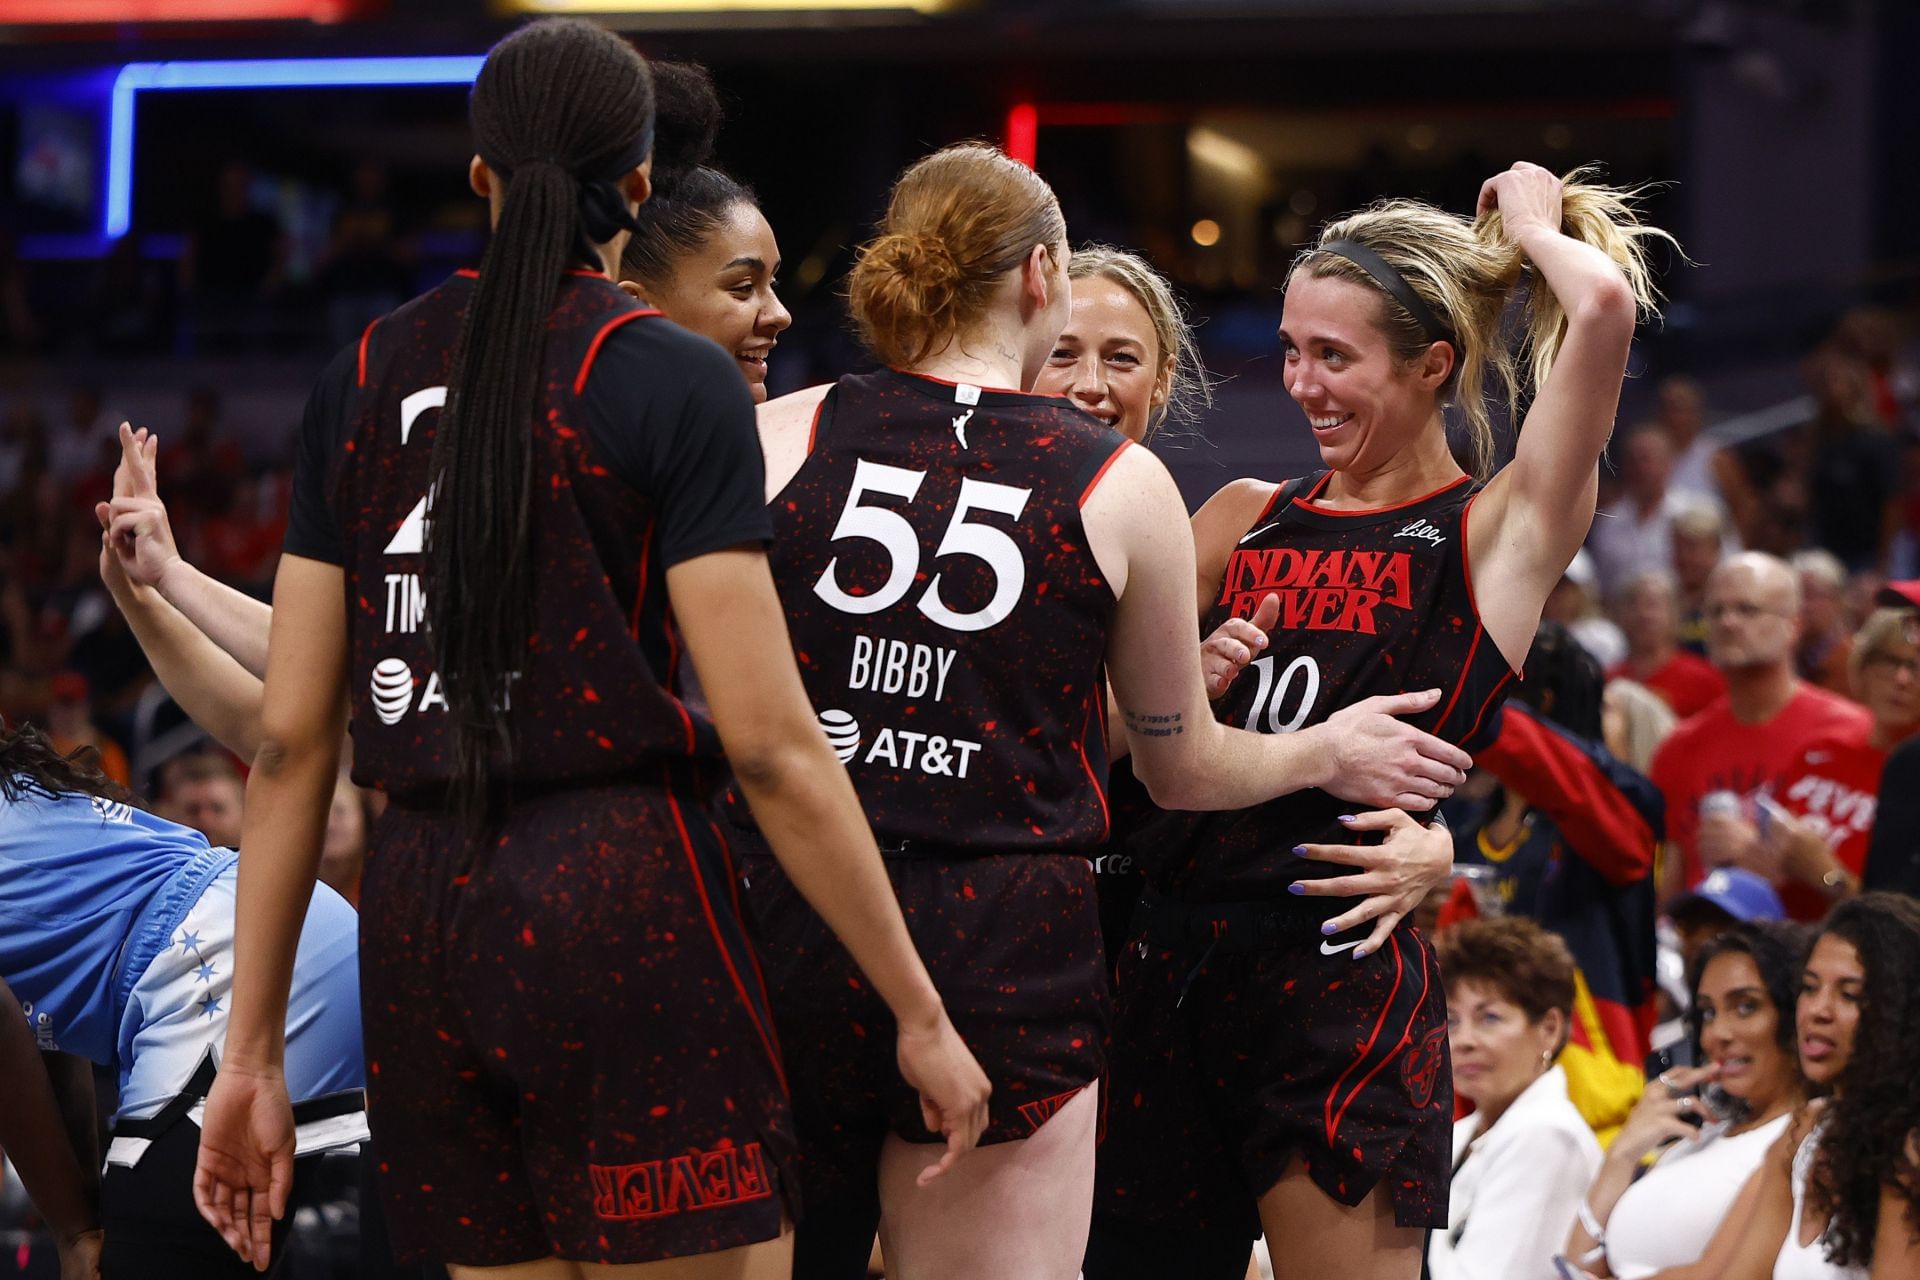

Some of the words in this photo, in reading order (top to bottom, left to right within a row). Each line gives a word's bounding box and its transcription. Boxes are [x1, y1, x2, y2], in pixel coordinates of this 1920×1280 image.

[812, 457, 1034, 632] 55
[1393, 518, 1447, 548] Lilly
[1218, 548, 1414, 611] INDIANA
[848, 634, 957, 702] BIBBY
[1243, 655, 1321, 734] 10
[864, 727, 982, 779] AT&T
[588, 1142, 773, 1220] FEVER
